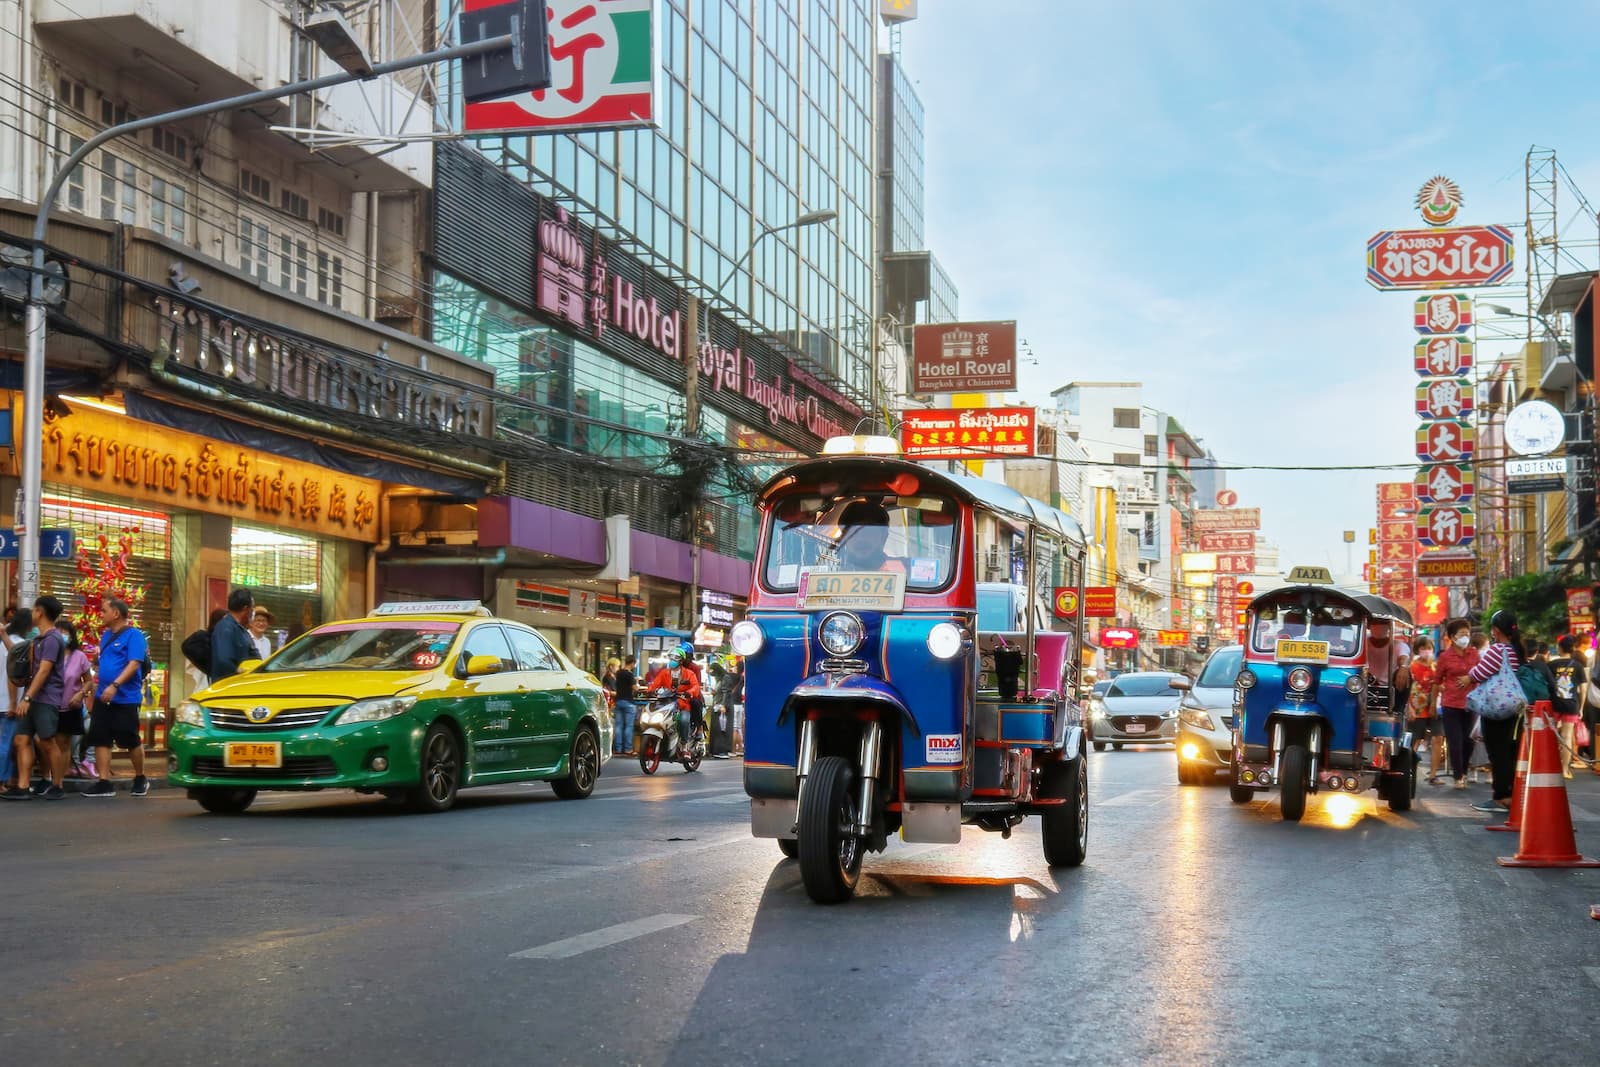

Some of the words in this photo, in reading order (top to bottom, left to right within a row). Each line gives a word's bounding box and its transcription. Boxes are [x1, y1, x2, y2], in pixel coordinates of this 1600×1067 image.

[613, 274, 680, 360] Hotel
[691, 335, 741, 393] oyal
[745, 357, 799, 425] Bangkok
[975, 332, 989, 358] 京华
[918, 361, 960, 377] Hotel
[965, 360, 1011, 377] Royal
[919, 380, 954, 389] Bangkok
[967, 378, 1011, 386] Chinatown
[1296, 568, 1324, 580] TAXI
[1420, 562, 1475, 574] EXCHANGE
[850, 577, 894, 593] 2674
